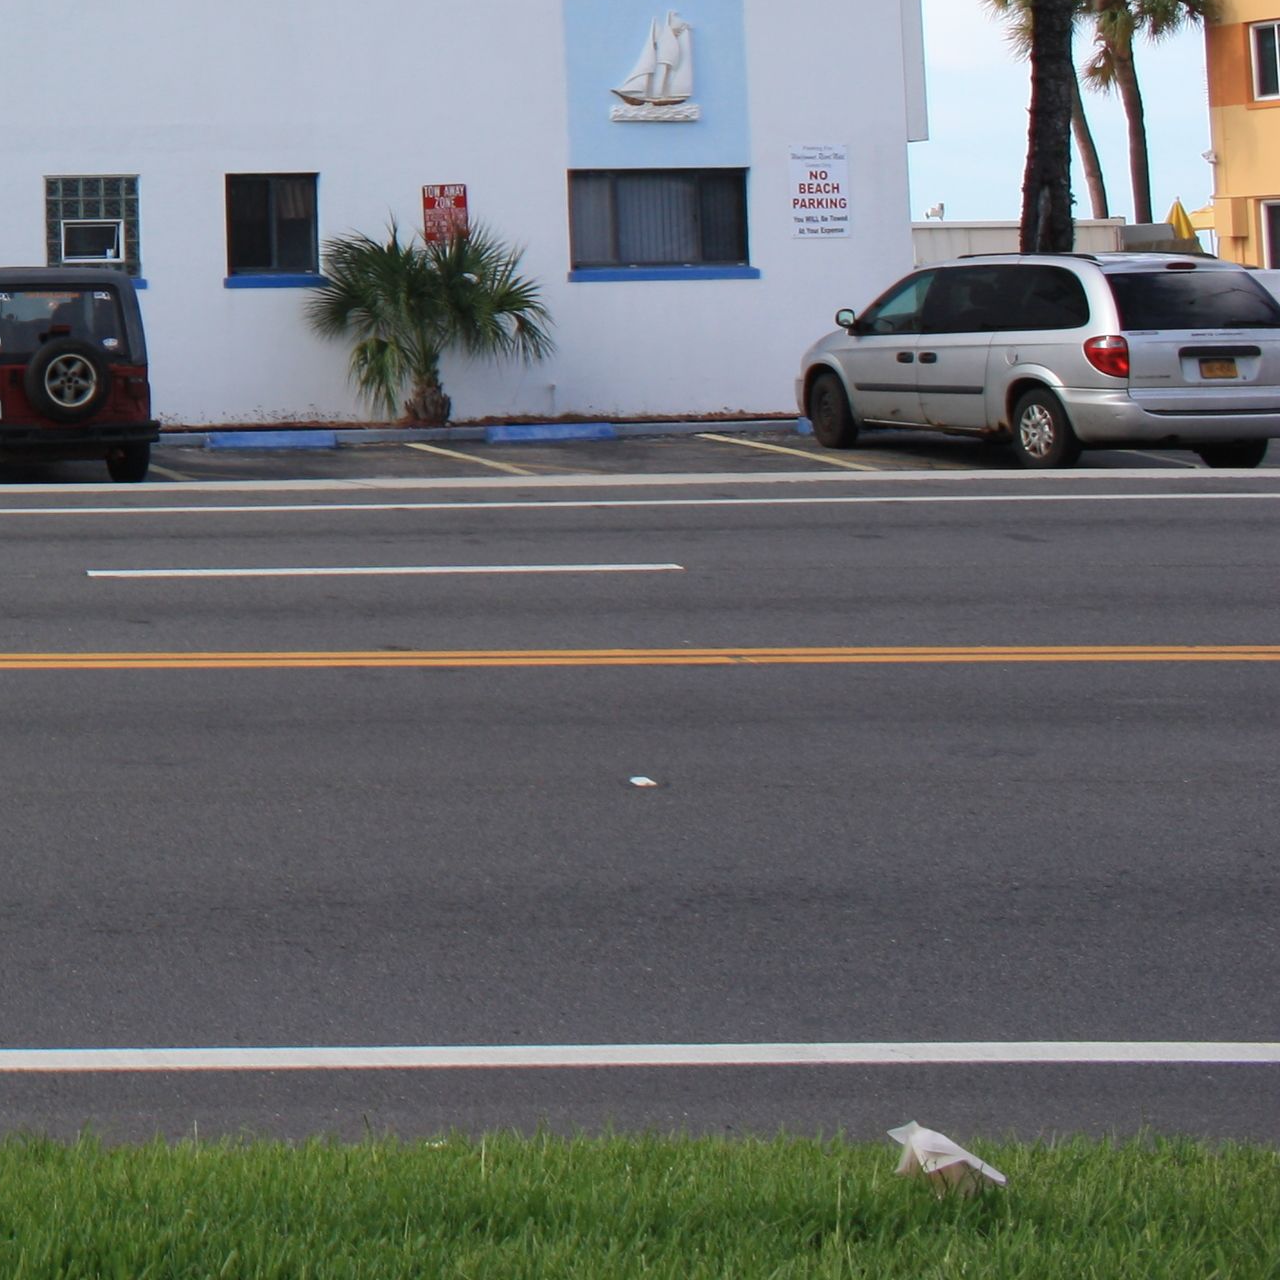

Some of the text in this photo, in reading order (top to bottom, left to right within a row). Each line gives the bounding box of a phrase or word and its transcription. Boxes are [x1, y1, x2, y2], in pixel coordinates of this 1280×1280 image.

[809, 170, 828, 180] NO
[799, 183, 840, 194] BEACH
[434, 197, 456, 209] ZONE
[792, 198, 847, 209] PARKING
